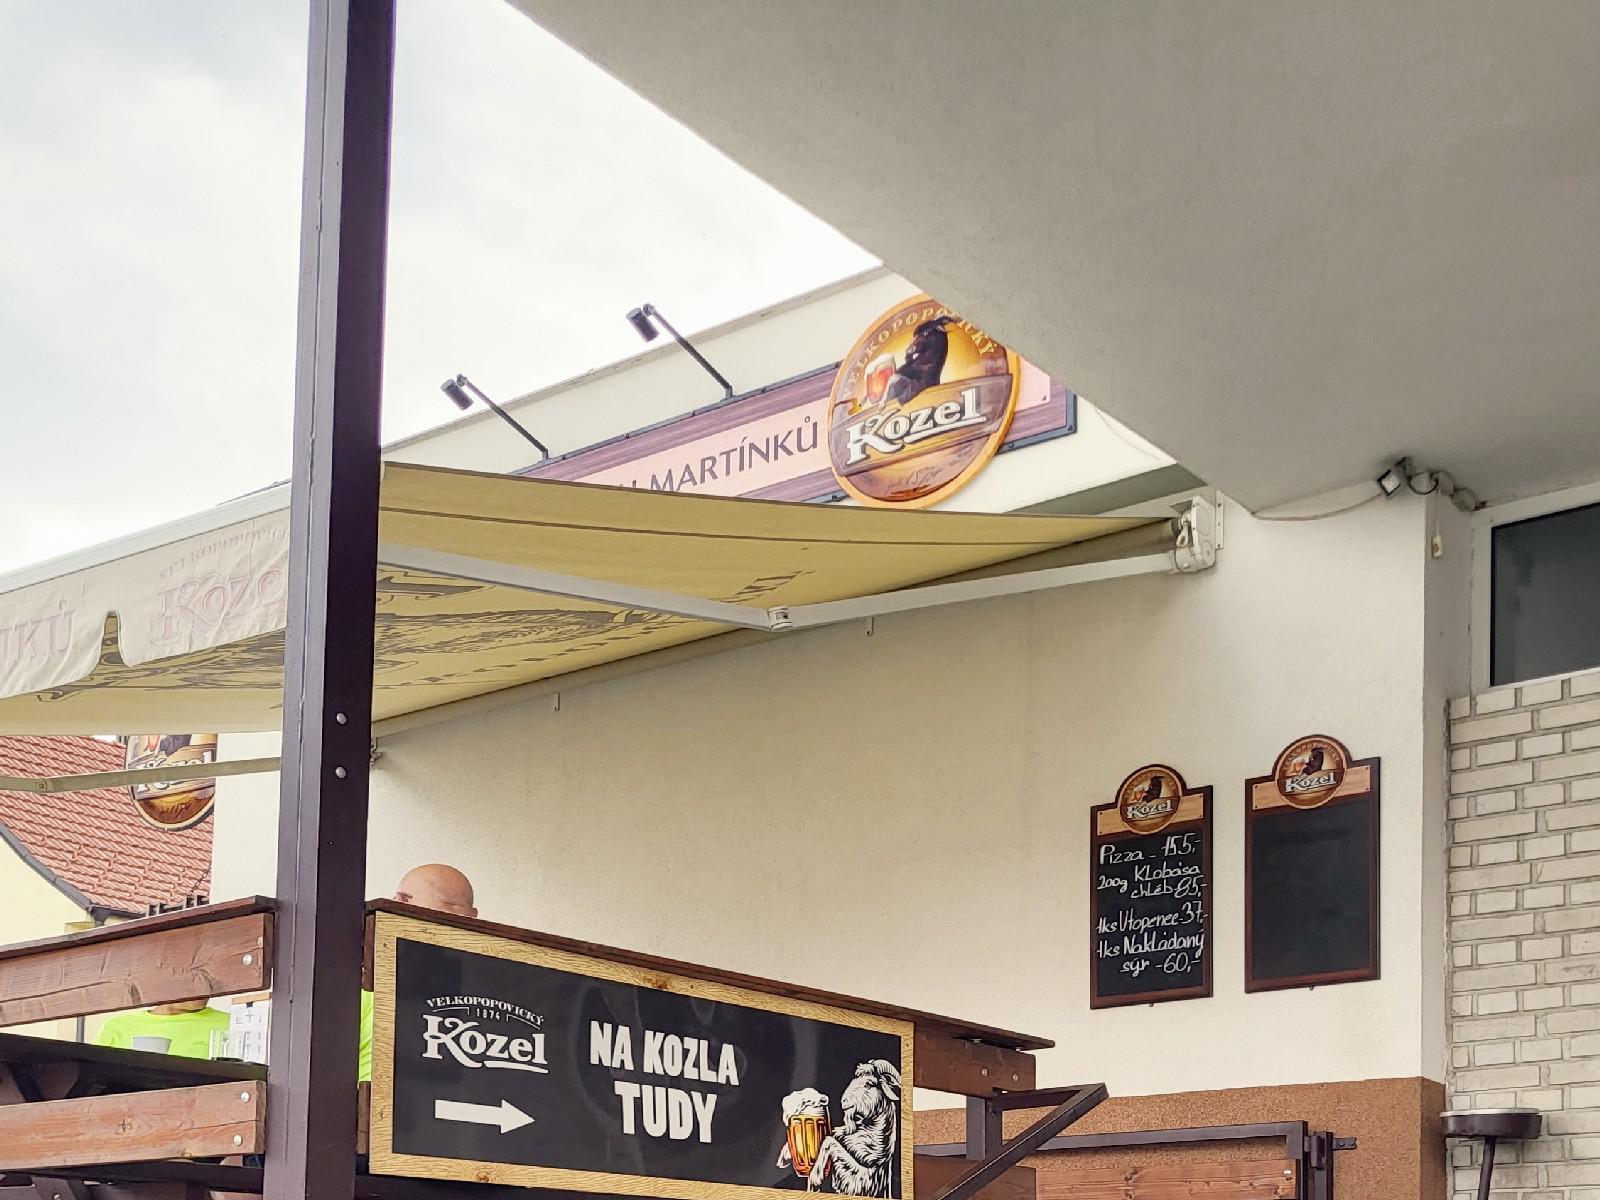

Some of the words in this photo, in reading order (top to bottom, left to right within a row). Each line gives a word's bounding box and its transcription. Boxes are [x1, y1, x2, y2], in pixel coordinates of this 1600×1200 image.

[846, 388, 986, 464] Kozel
[1285, 772, 1337, 793] Kozel
[1126, 799, 1174, 819] Kozel
[1100, 844, 1144, 865] Pizza
[1097, 875, 1128, 893] 200g
[1096, 917, 1118, 934] 1ks
[1096, 940, 1120, 958] 1ks
[426, 995, 545, 1026] VELKOPOPOVICKÝ
[476, 1008, 501, 1021] 1874
[422, 1014, 549, 1071] Kozel
[590, 1020, 635, 1071] NA
[643, 1030, 740, 1086] KOZLA
[614, 1080, 718, 1144] TUDY
